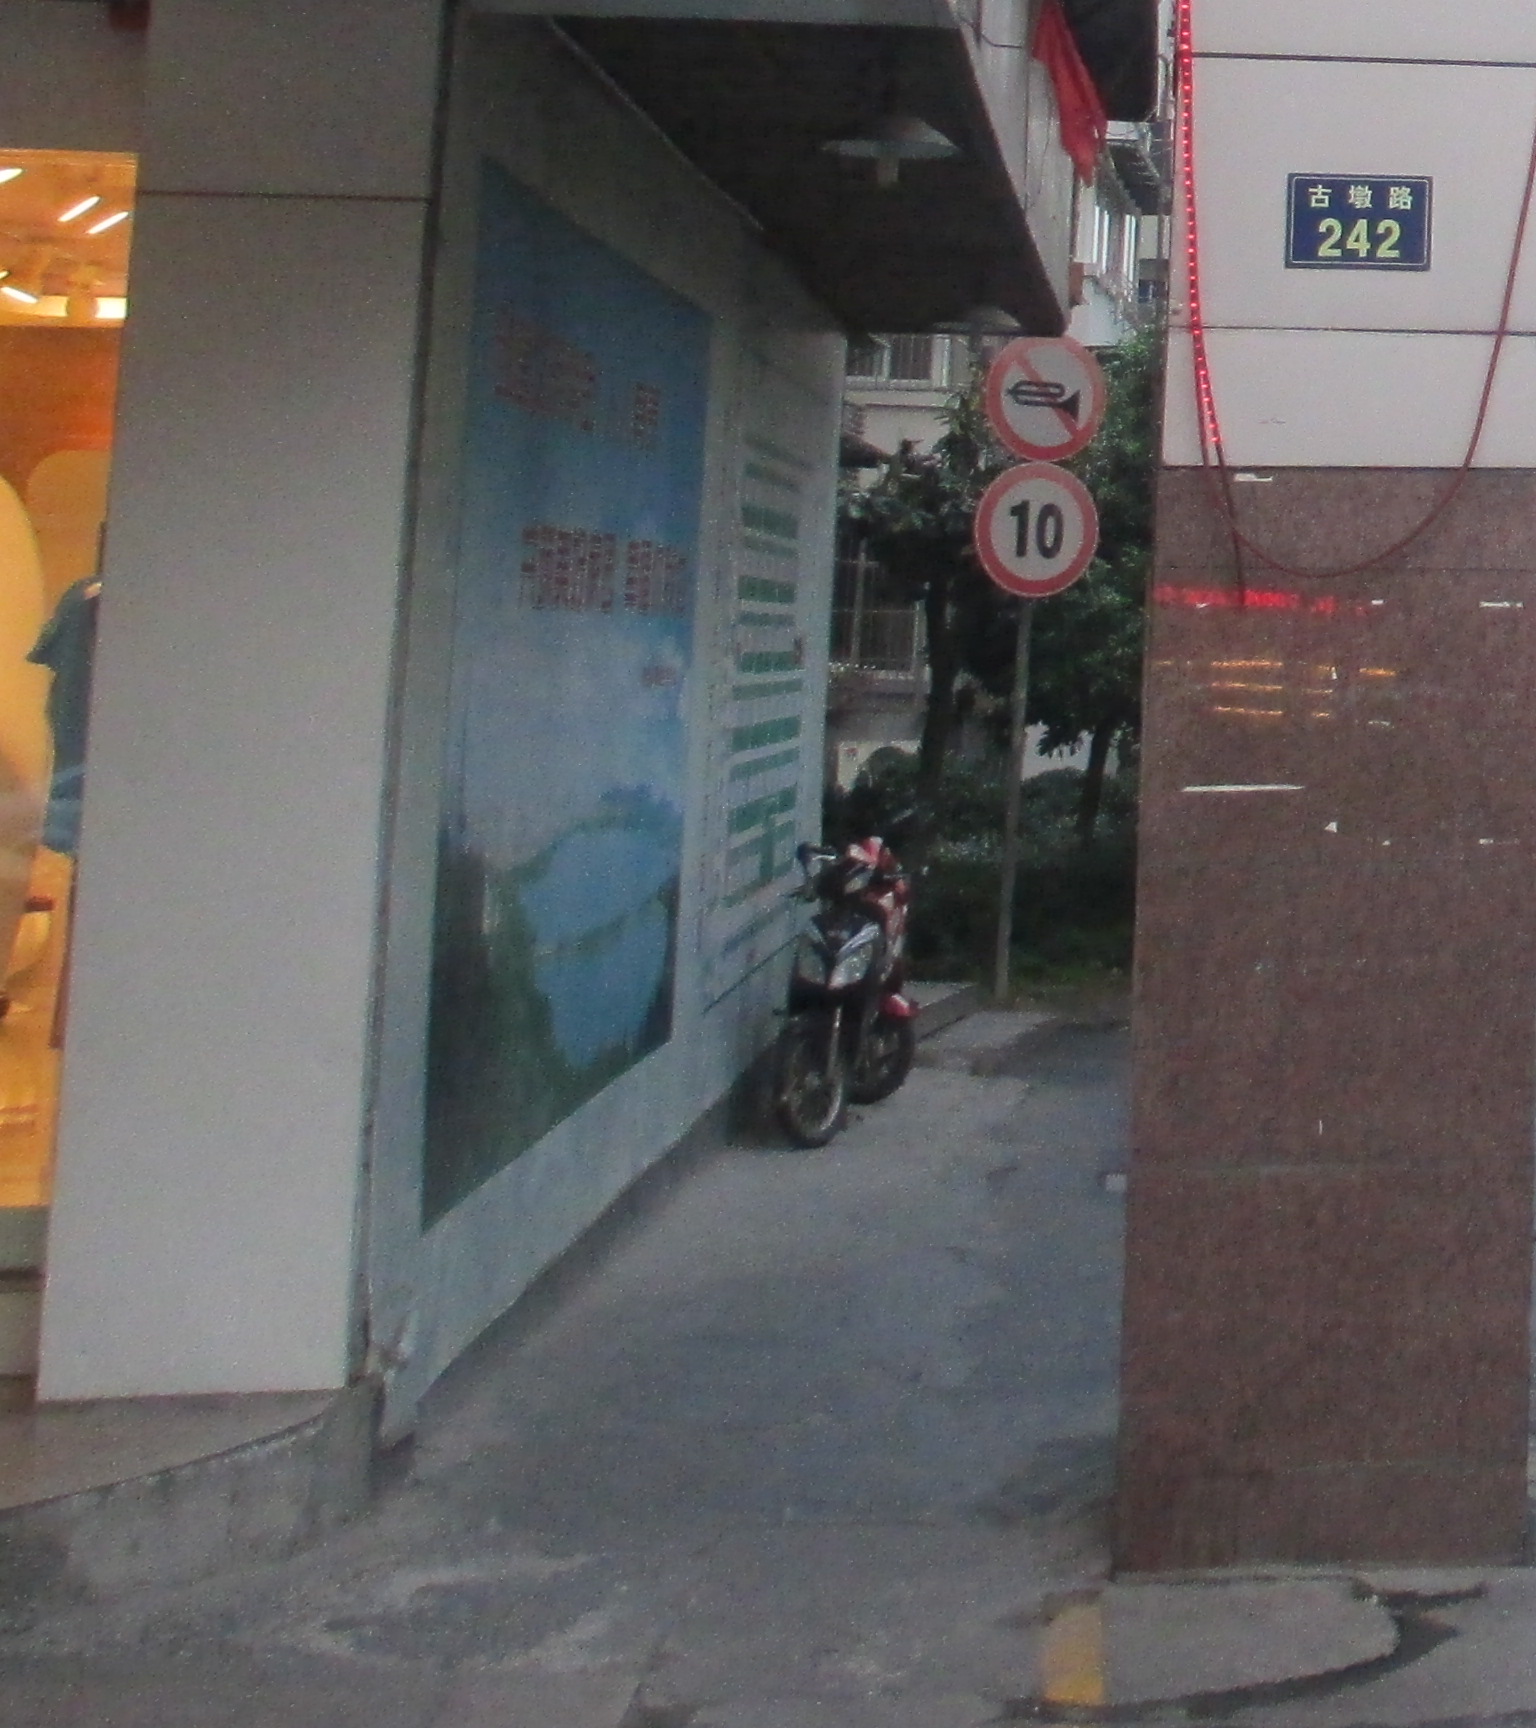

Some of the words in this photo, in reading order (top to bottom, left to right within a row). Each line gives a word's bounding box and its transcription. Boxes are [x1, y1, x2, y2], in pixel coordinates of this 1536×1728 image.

[1308, 184, 1414, 211] 古墩路
[1317, 217, 1401, 259] 242
[1010, 499, 1065, 560] 10
